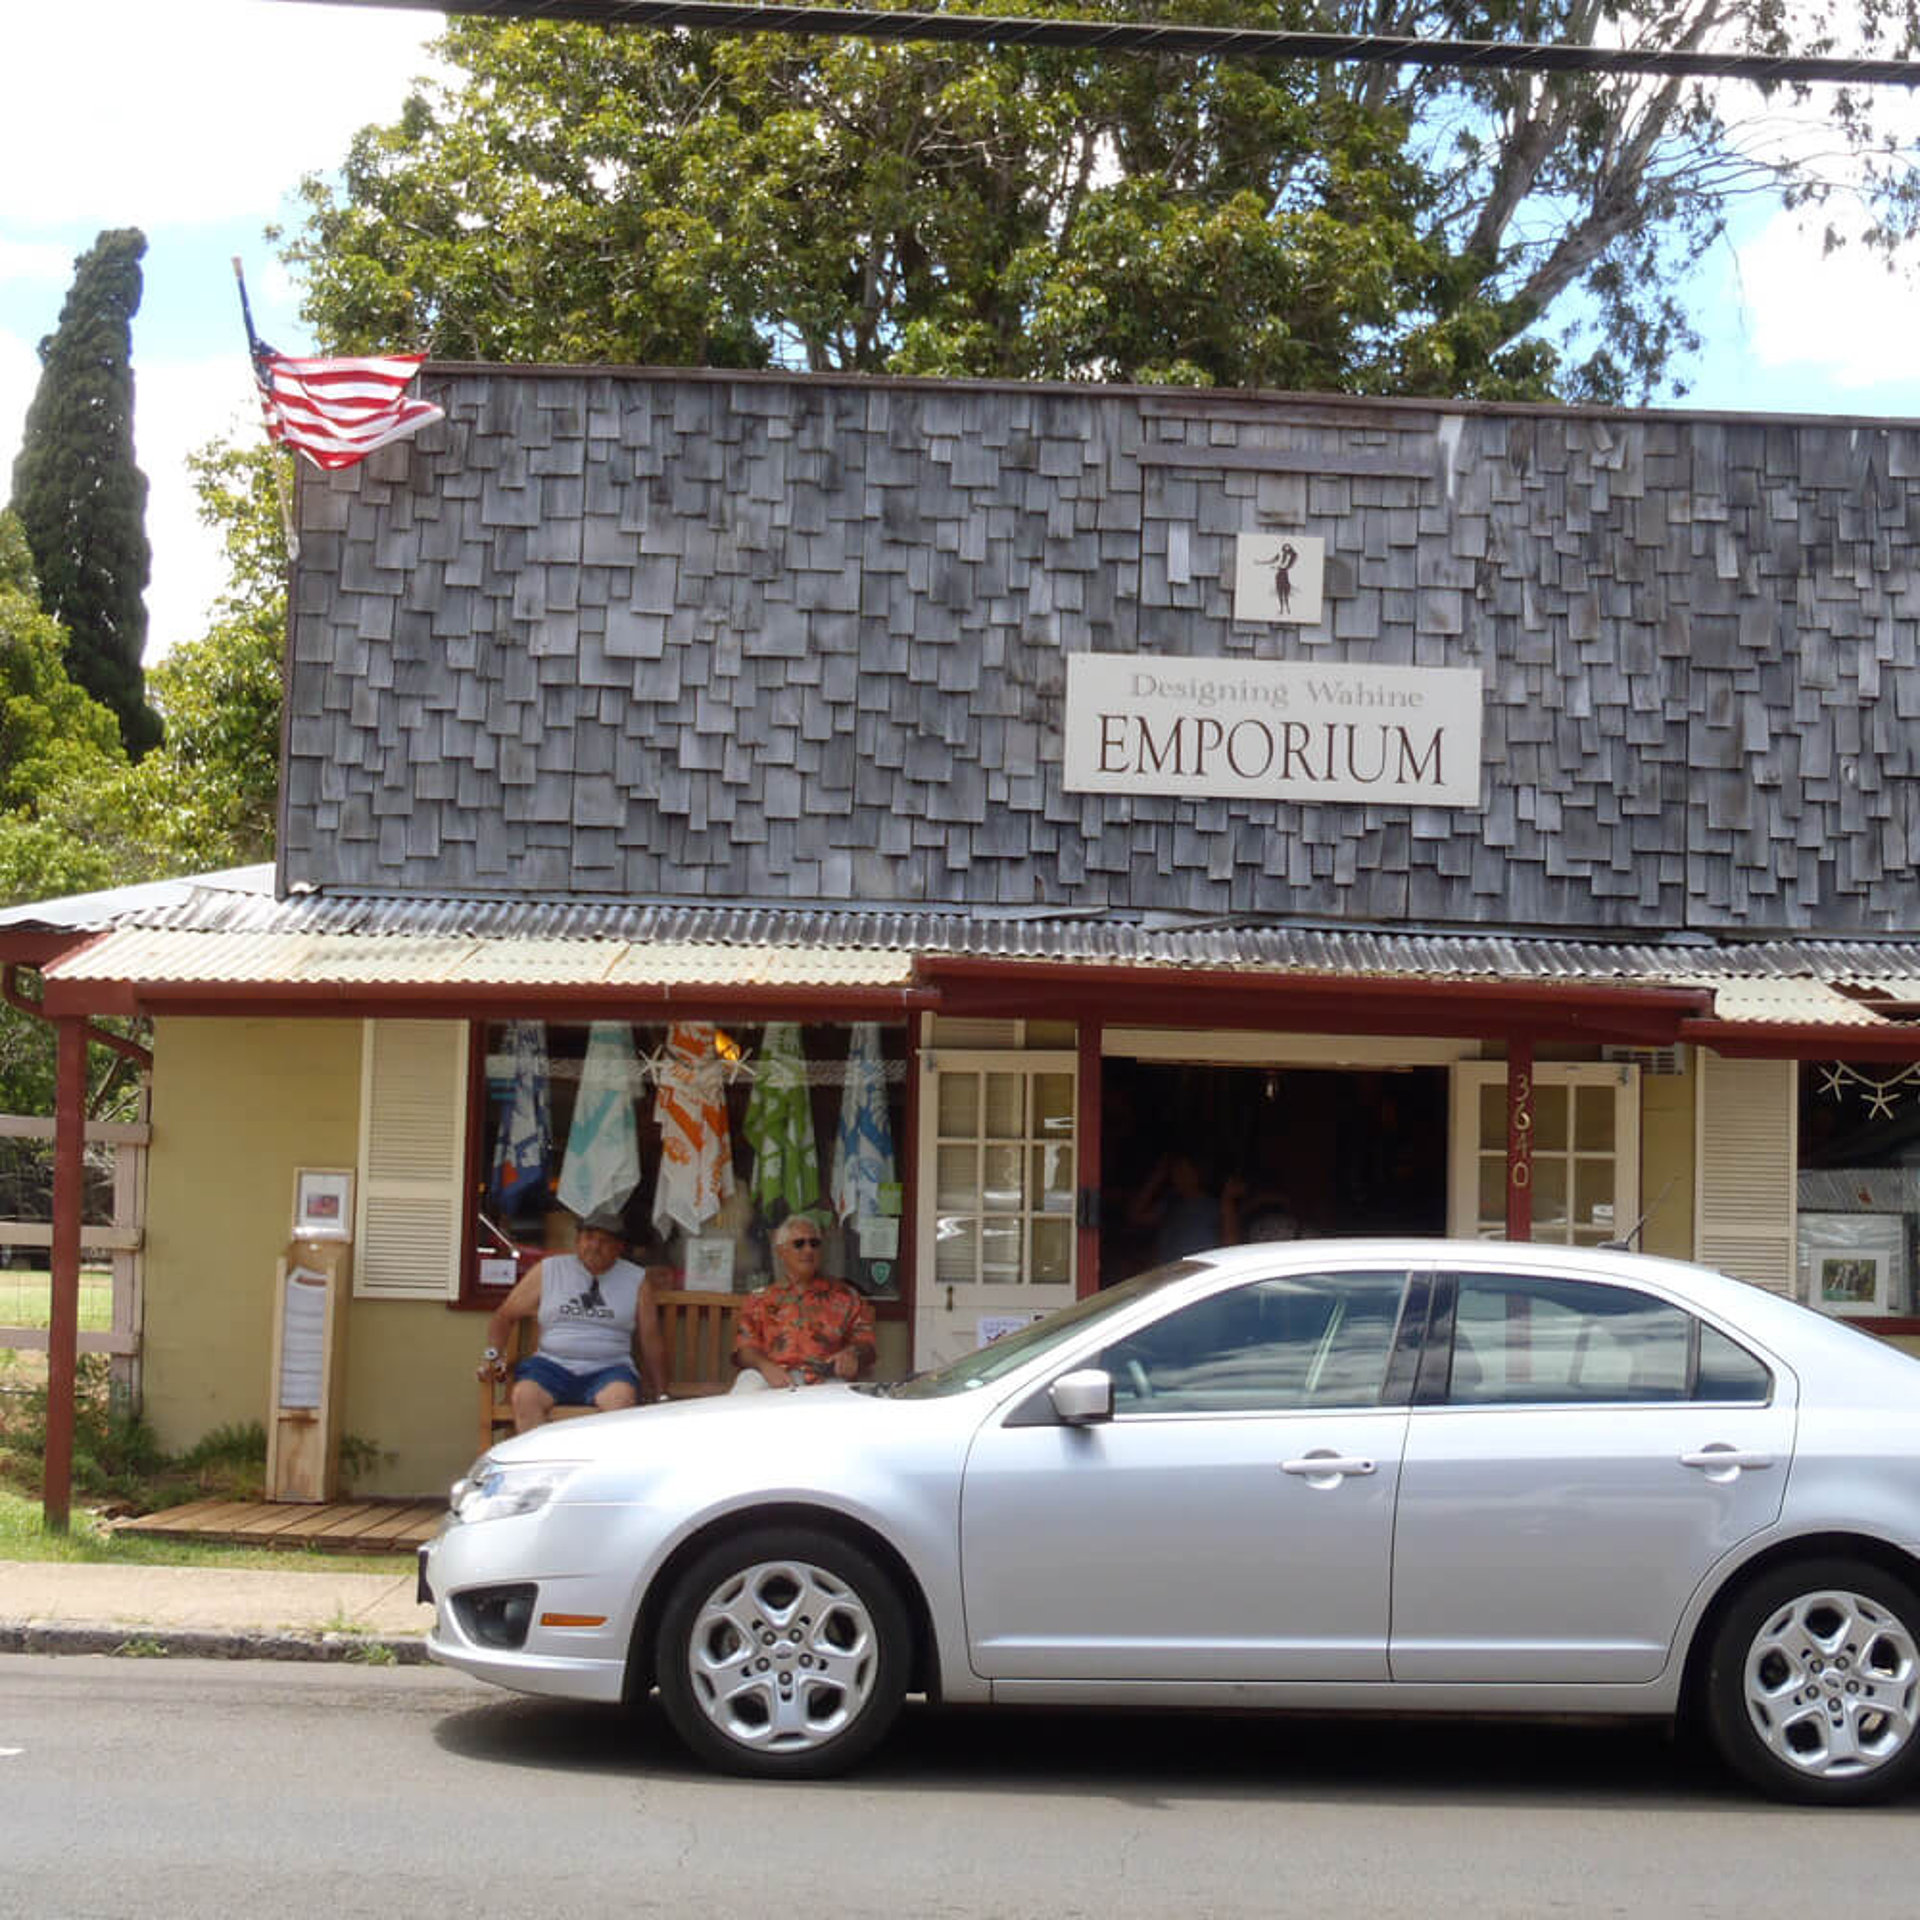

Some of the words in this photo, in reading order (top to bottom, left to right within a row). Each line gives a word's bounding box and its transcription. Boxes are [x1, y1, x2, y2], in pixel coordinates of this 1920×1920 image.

[1132, 674, 1288, 708] Designing
[1308, 681, 1424, 707] Wahine
[1097, 714, 1446, 786] EMPORIUM
